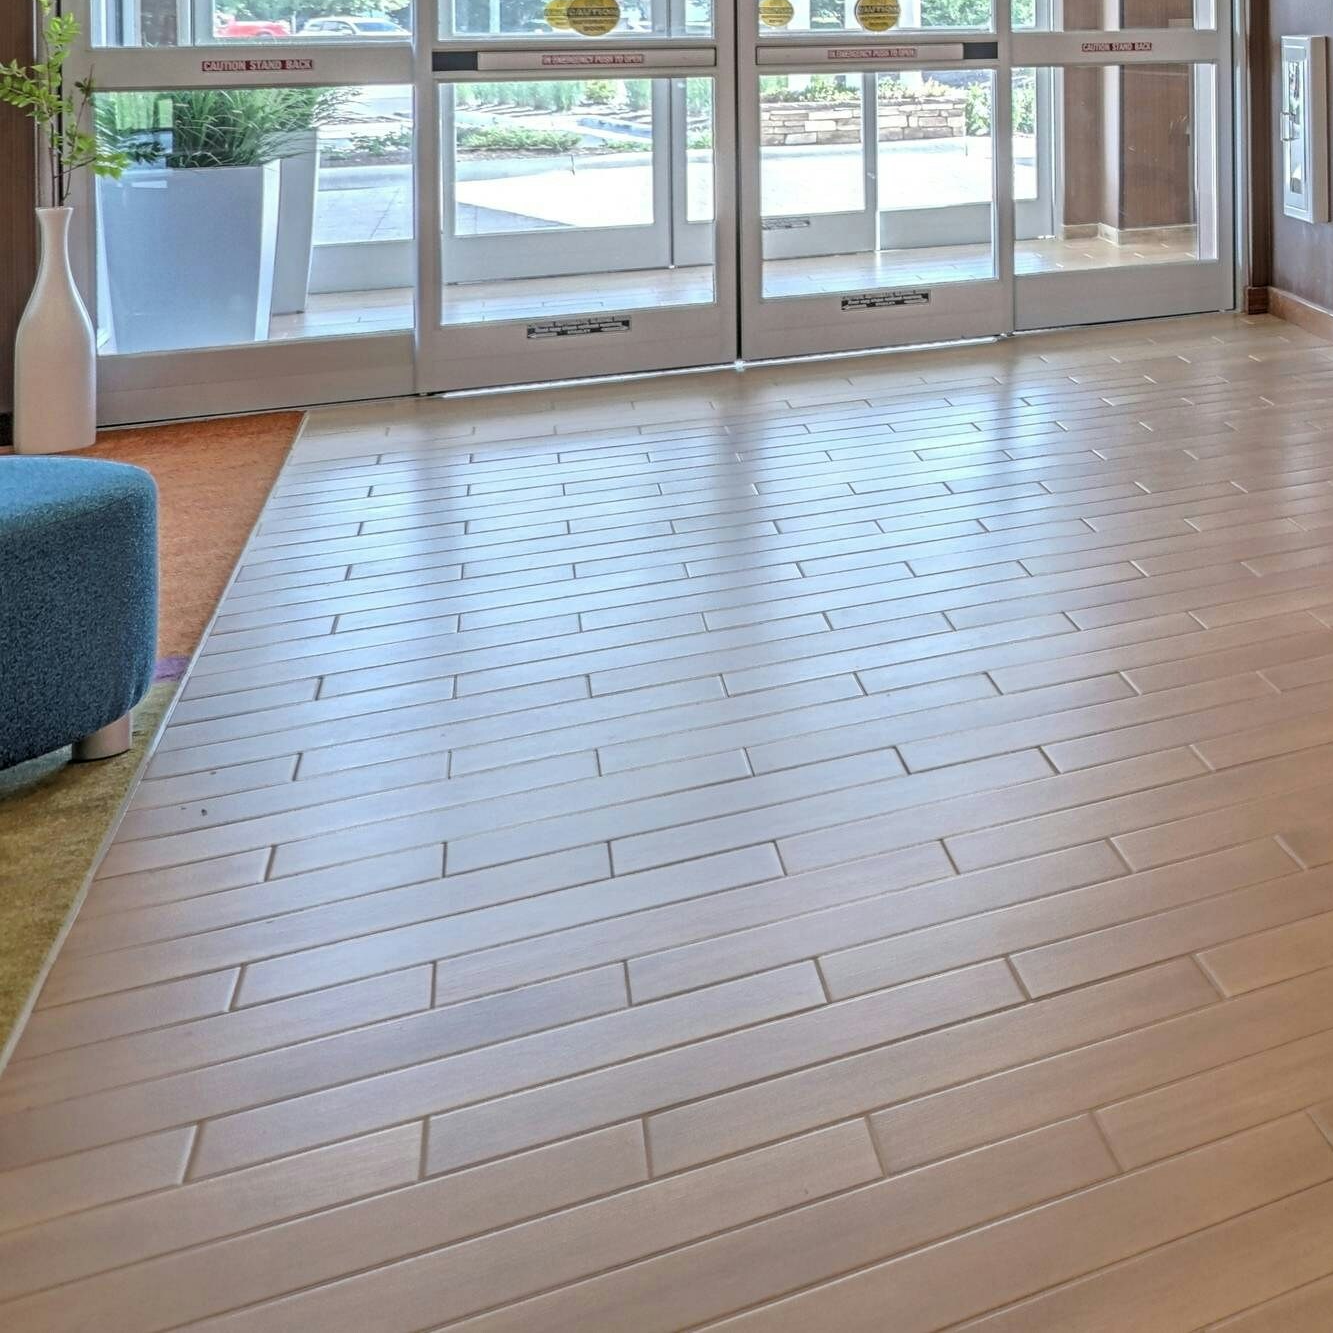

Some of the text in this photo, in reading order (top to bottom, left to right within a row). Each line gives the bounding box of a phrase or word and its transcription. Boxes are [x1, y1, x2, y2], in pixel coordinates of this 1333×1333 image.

[1082, 42, 1110, 52] CAUTION
[1112, 42, 1133, 51] STAND
[203, 59, 312, 71] CAUTION STAND BACK
